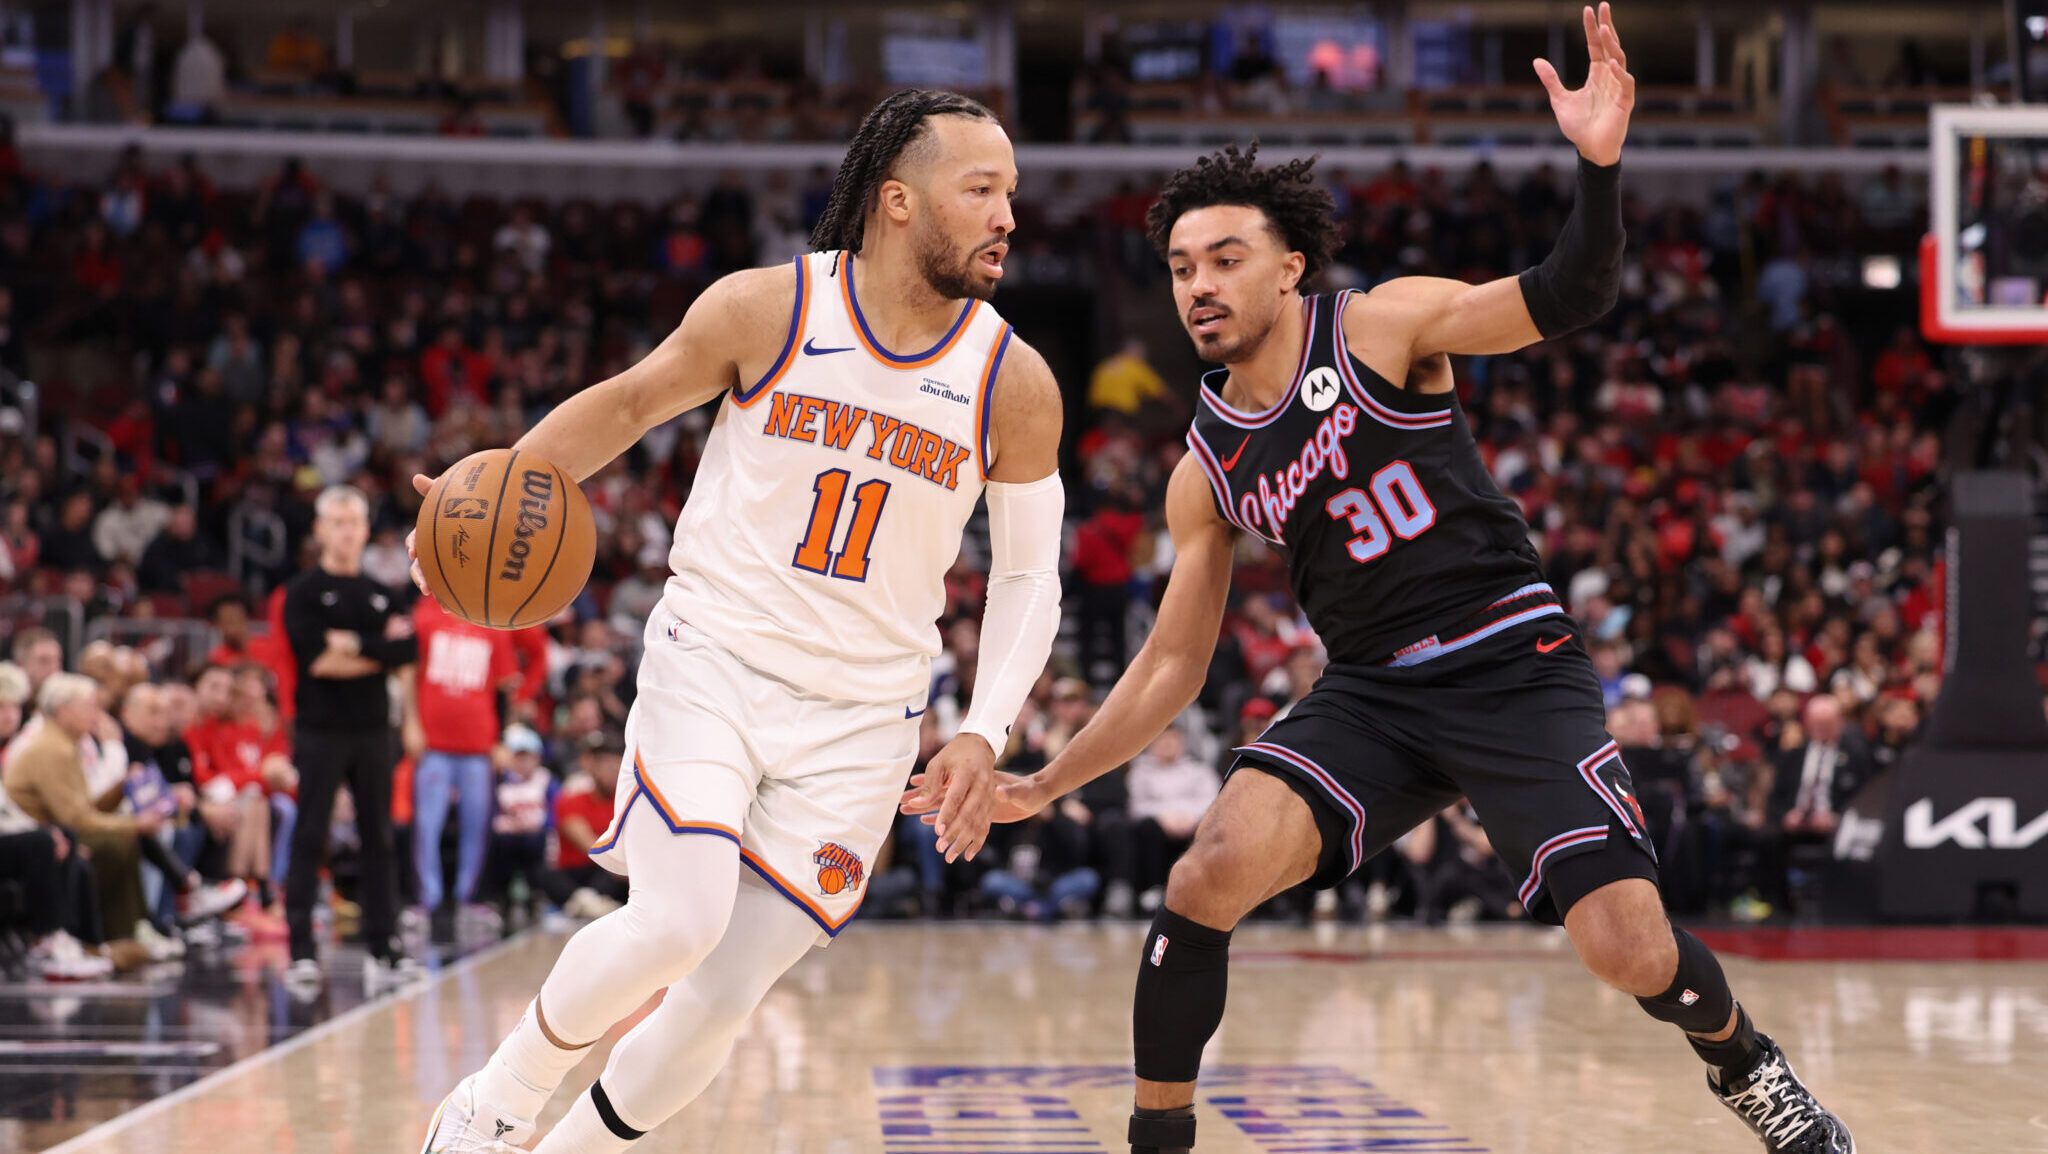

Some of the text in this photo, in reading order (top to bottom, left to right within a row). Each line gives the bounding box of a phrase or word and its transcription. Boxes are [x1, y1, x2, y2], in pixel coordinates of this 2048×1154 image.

[763, 391, 972, 491] NEW YORK
[920, 384, 971, 405] abu dhabi
[500, 469, 553, 581] Wilson
[791, 467, 891, 583] 11
[1239, 402, 1358, 545] Chicago
[1325, 460, 1437, 563] 30
[813, 842, 864, 891] KNICKS
